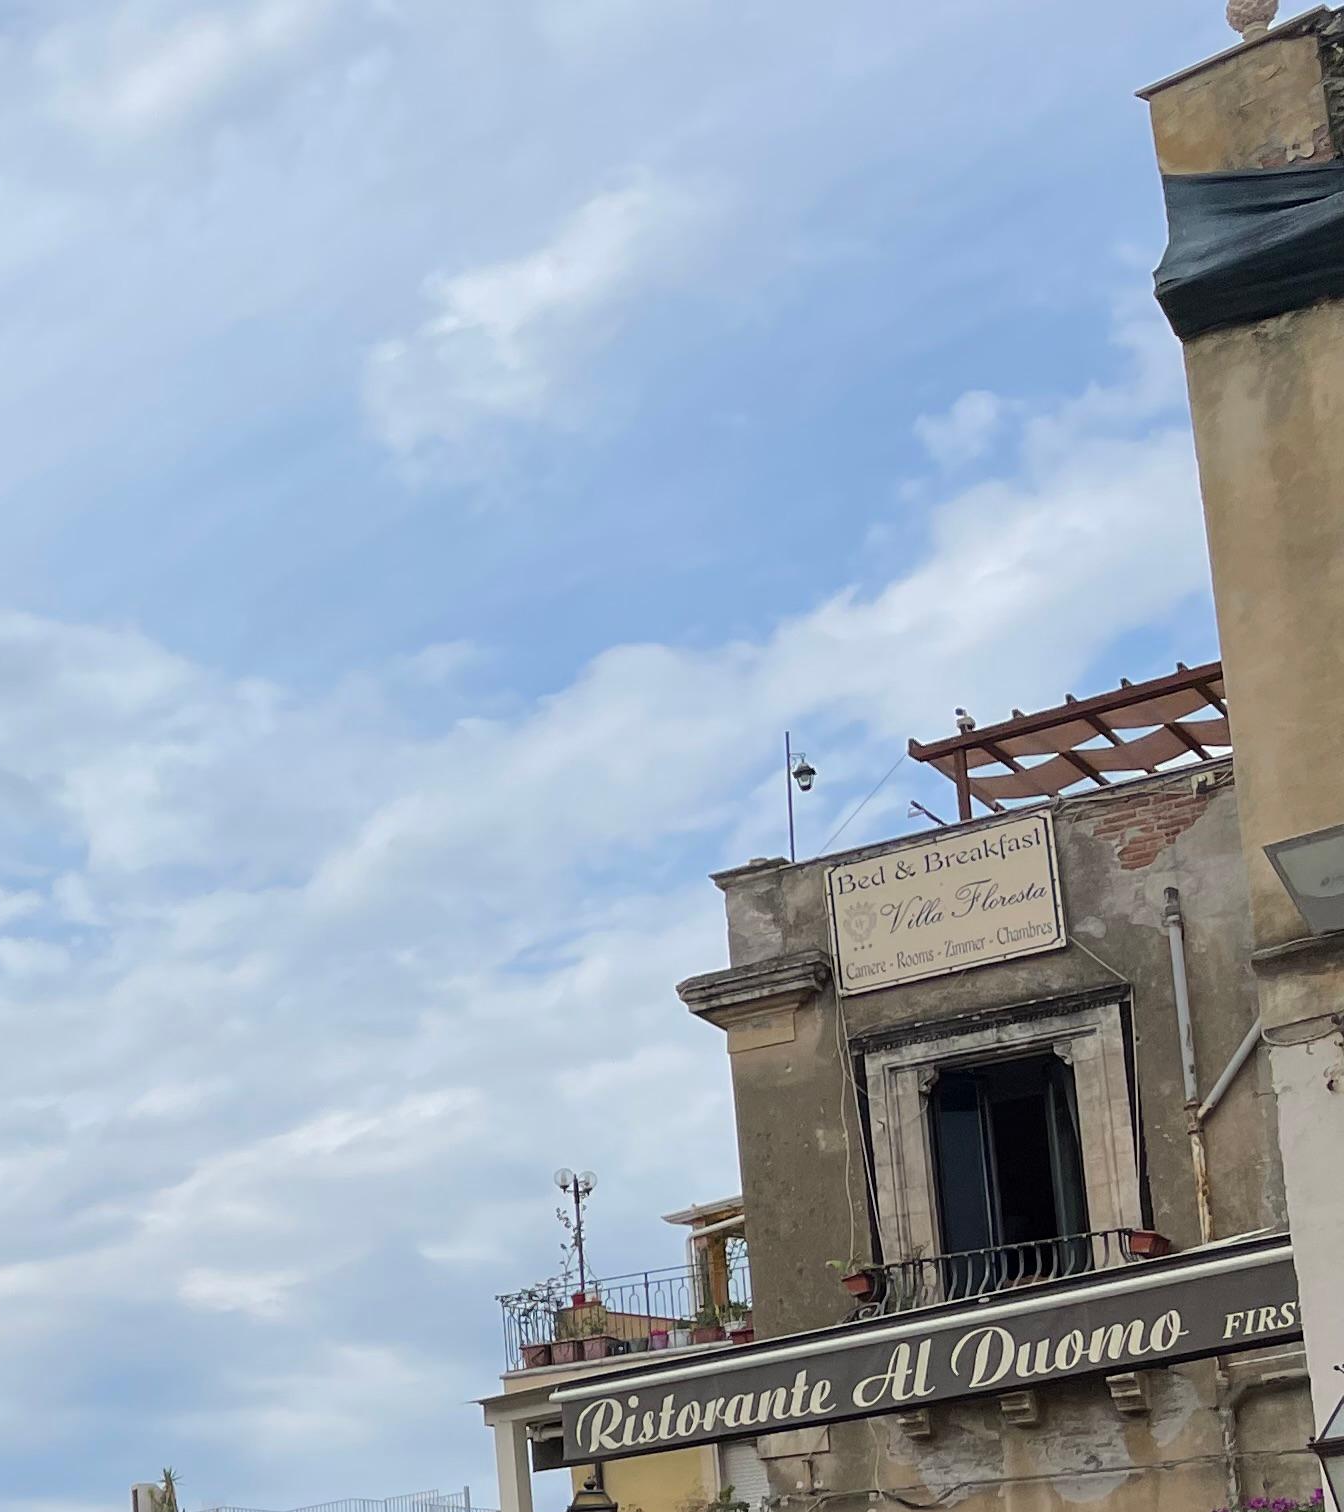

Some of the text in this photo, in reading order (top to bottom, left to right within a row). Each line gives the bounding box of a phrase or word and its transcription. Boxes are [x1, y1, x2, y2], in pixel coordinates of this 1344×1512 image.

[838, 828, 1041, 895] Bed & Breakfast
[880, 878, 1048, 935] Villa Floresta
[845, 961, 887, 981] Camere
[896, 950, 935, 969] Rooms
[944, 938, 986, 958] Zimmer
[996, 920, 1053, 945] Chambres
[576, 1301, 1302, 1453] Ristorante Al Duomo FIRS
